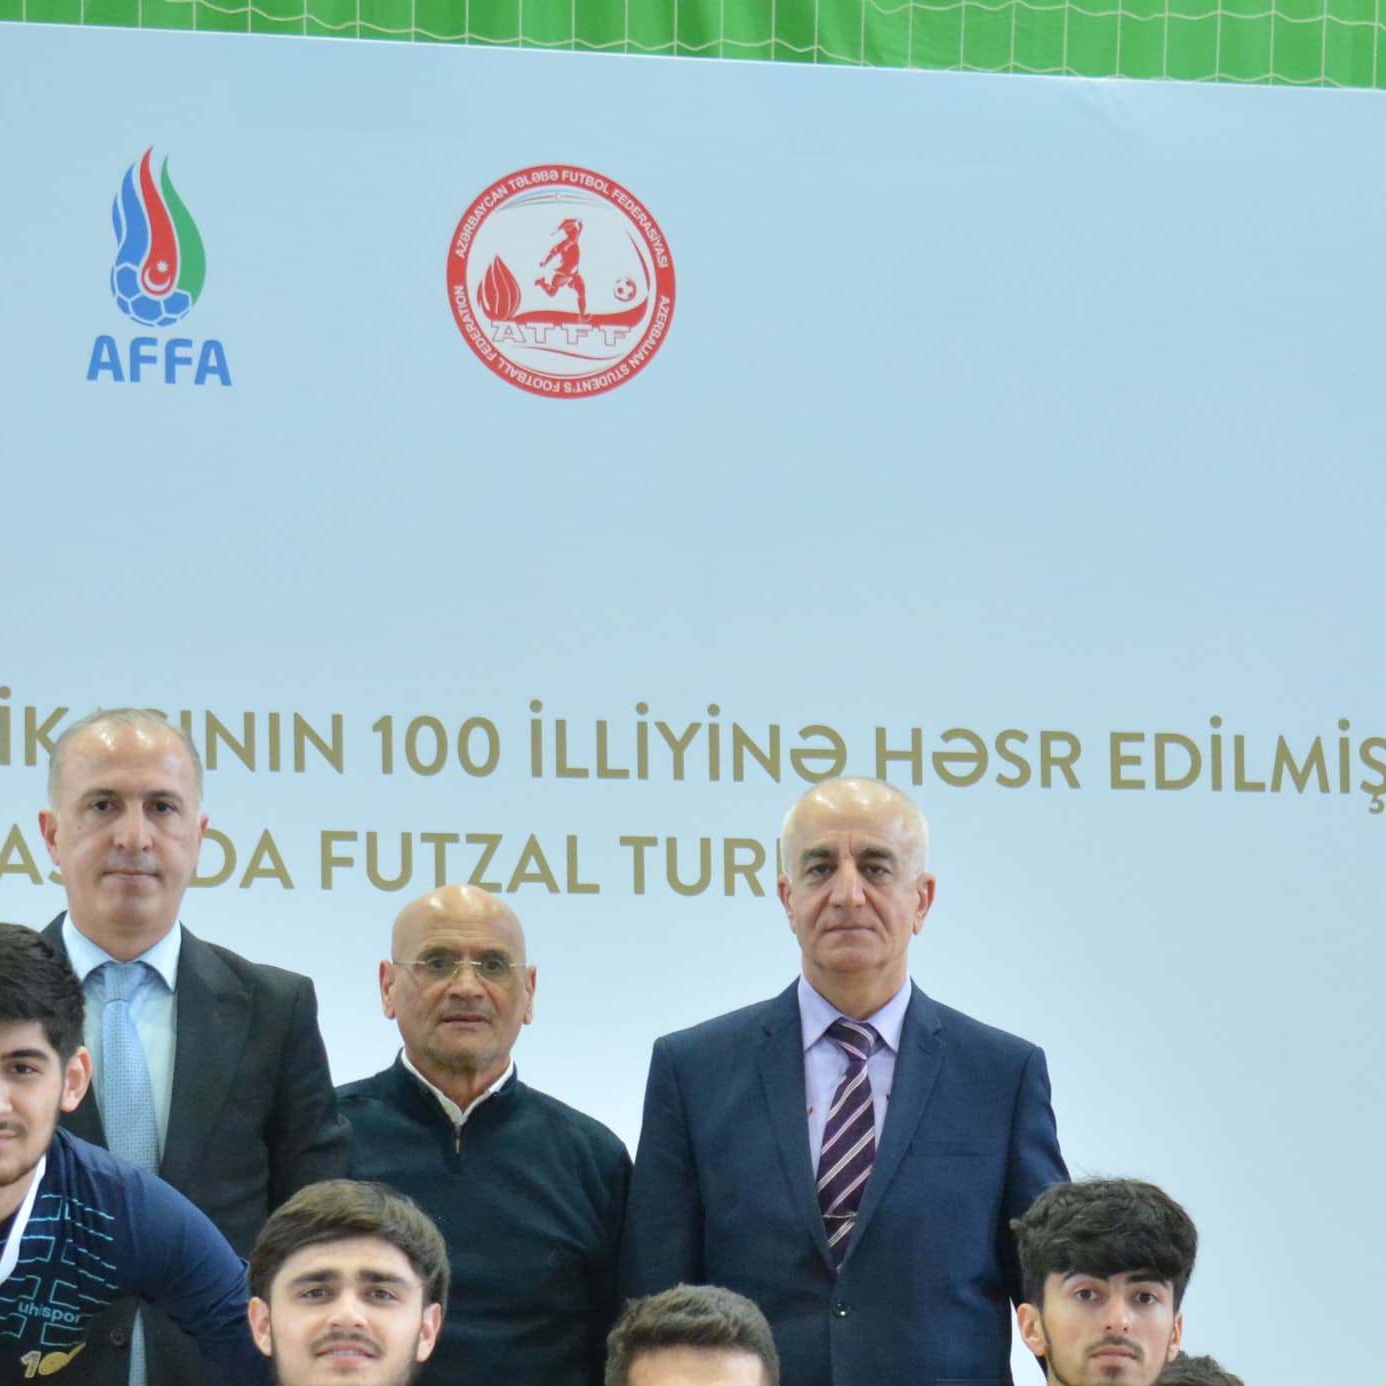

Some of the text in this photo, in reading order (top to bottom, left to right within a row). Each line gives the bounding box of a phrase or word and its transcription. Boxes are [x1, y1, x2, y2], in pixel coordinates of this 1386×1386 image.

[508, 169, 559, 191] TƏLƏBƏ
[561, 170, 610, 195] FUTBOL
[490, 319, 631, 347] ATFF
[86, 334, 232, 387] AFFA
[498, 356, 561, 392] FOOTBALL
[371, 712, 501, 778] 100
[528, 698, 848, 784] İLLİYİNƏ
[875, 726, 1082, 790] HƏSR
[320, 828, 601, 893] FUTZAL
